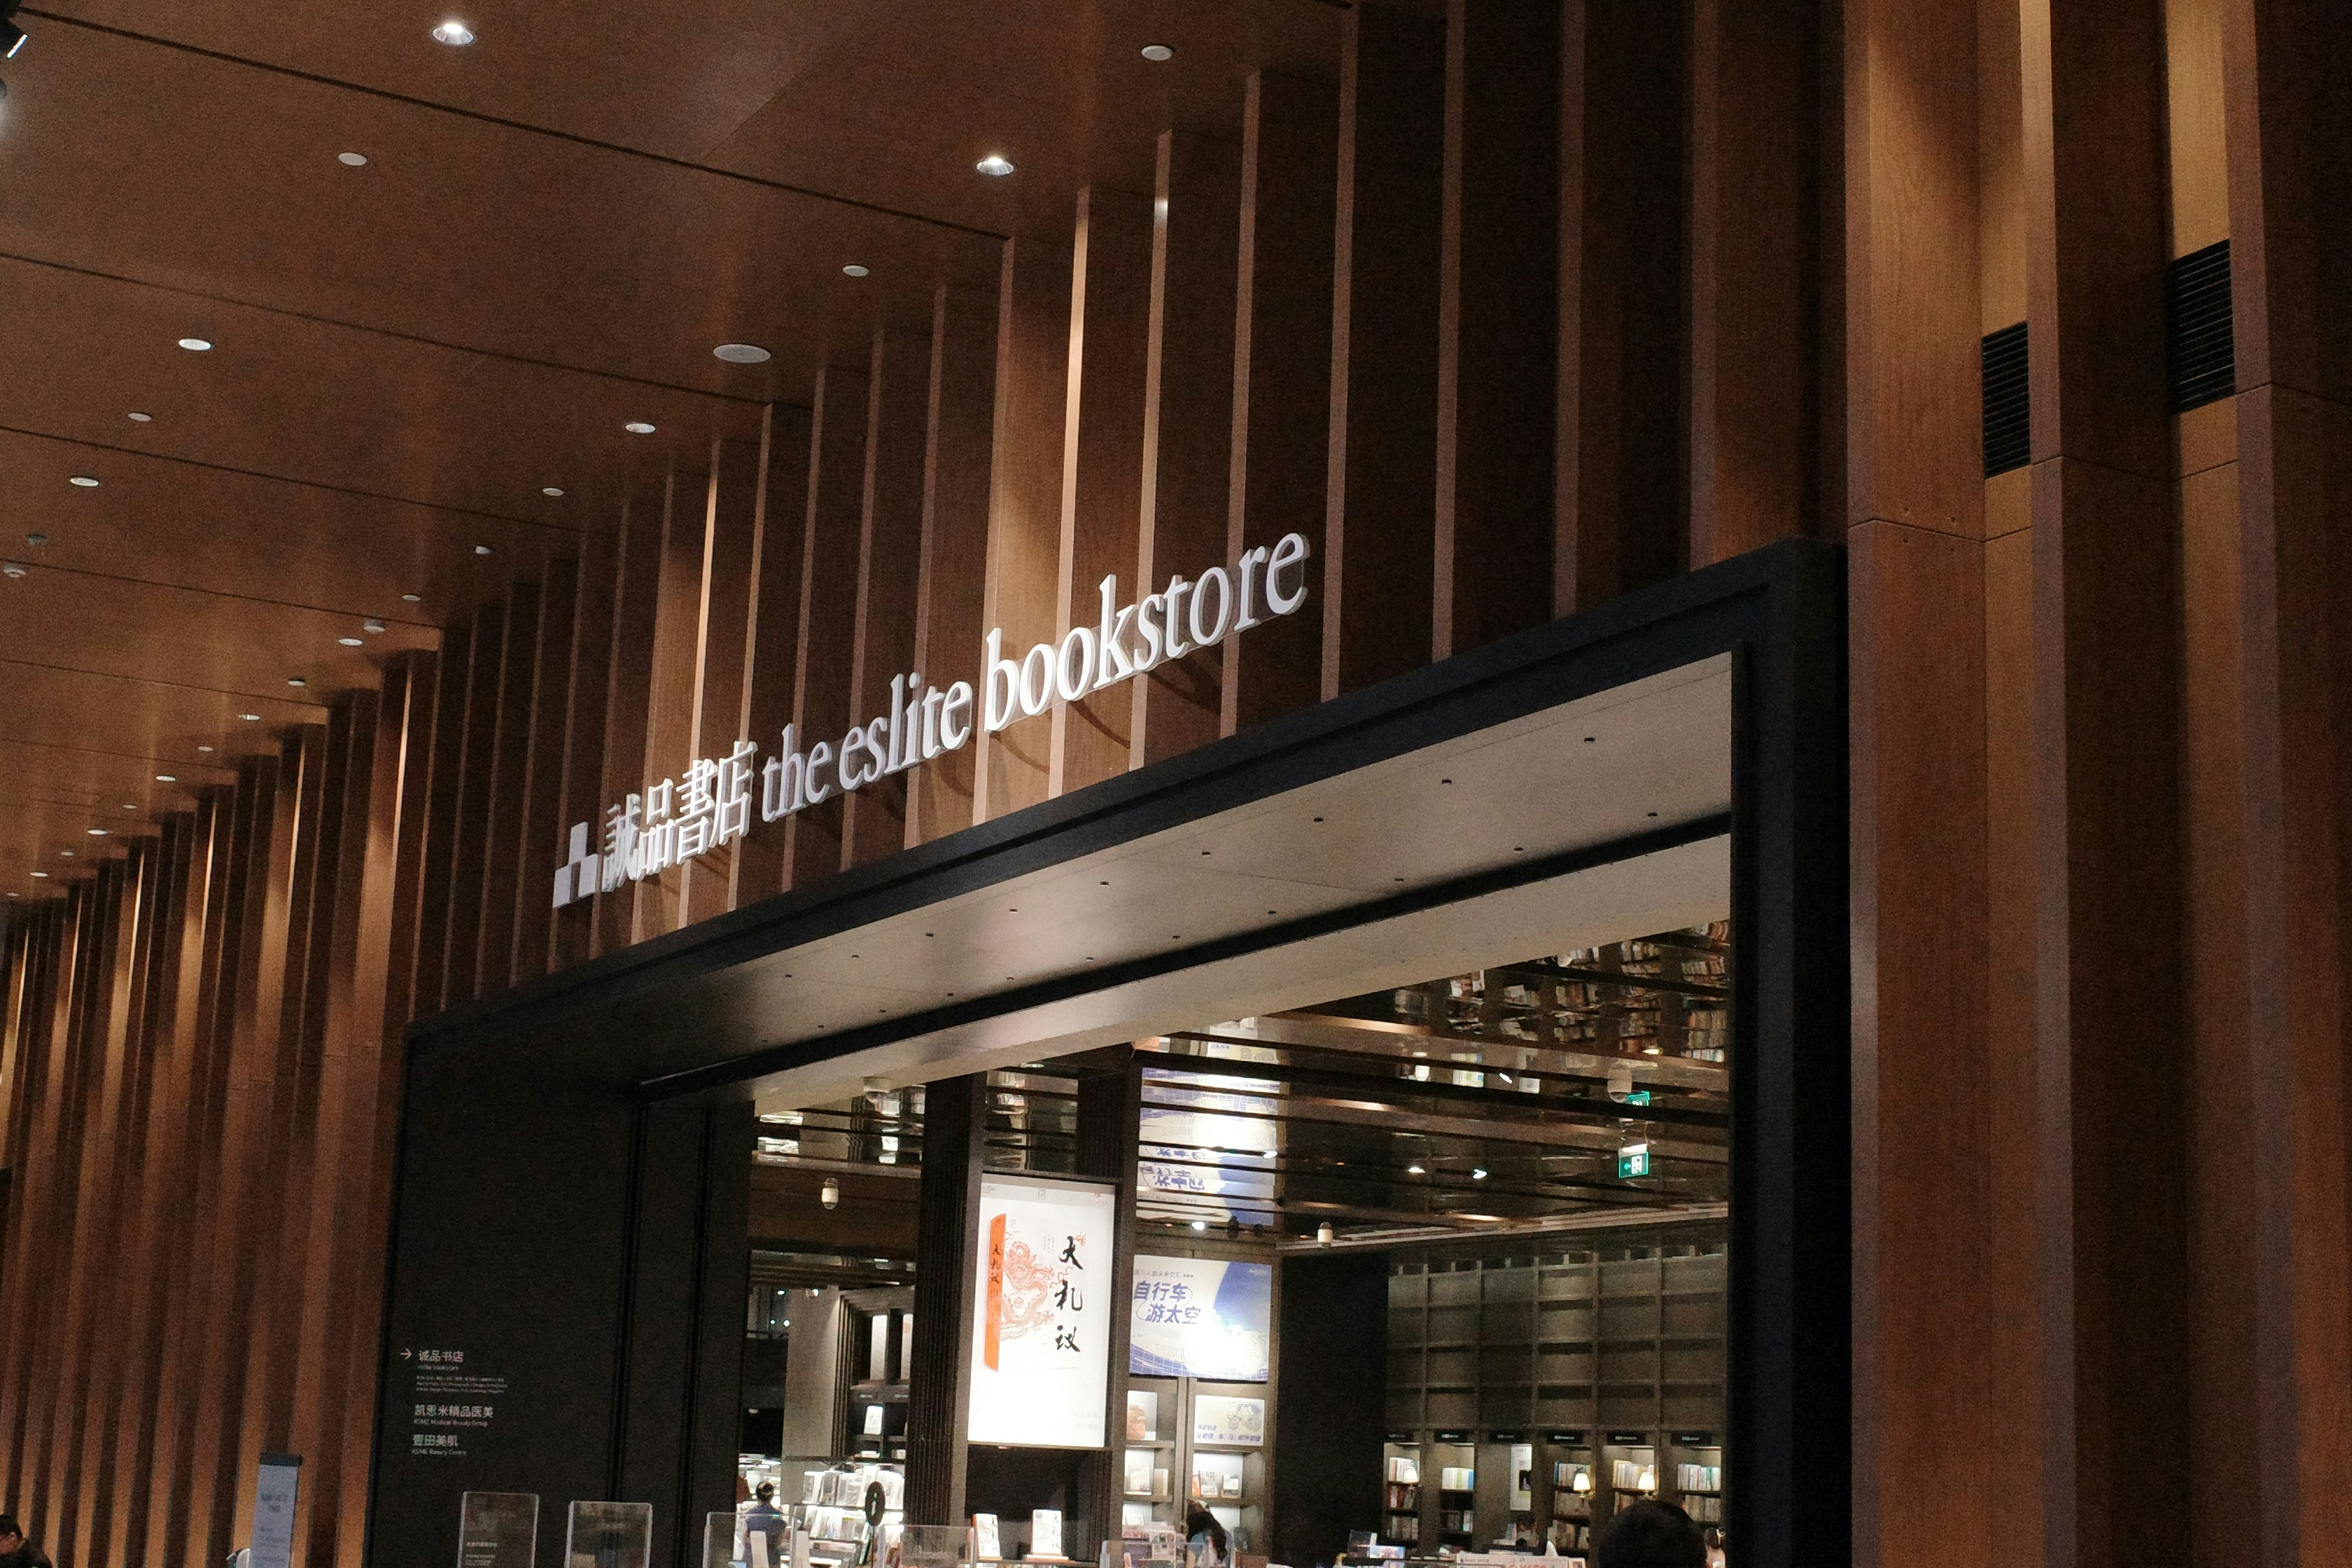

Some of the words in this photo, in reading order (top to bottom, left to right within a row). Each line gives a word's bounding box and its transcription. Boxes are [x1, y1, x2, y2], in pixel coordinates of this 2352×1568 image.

[761, 722, 833, 823] the
[838, 672, 972, 792] eslite
[983, 533, 1311, 734] bookstore
[603, 739, 758, 892] 誠品書店
[1133, 1280, 1189, 1301] 自行车
[1145, 1303, 1201, 1324] 游太空
[418, 1350, 464, 1362] 诚品书店
[414, 1404, 493, 1418] 凯思米精品医美
